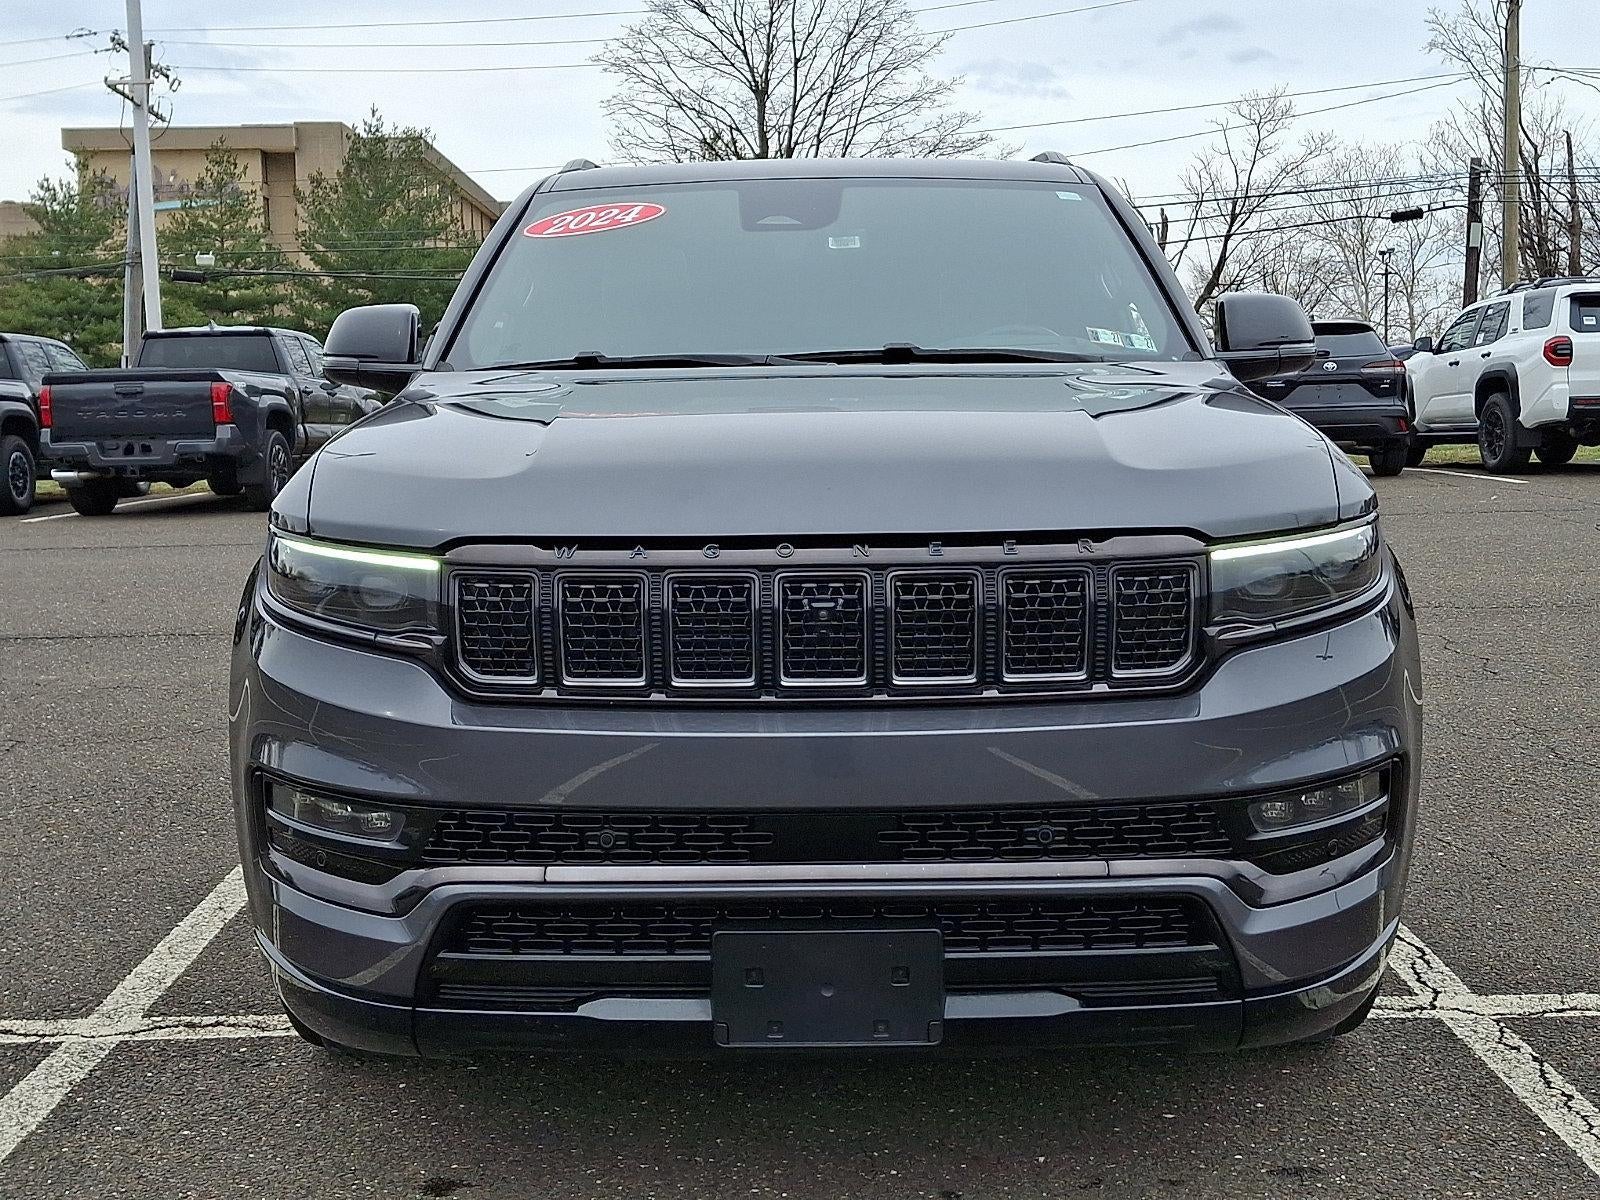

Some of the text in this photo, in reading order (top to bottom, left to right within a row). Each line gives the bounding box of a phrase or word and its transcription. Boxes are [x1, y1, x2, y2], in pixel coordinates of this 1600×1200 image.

[543, 205, 645, 235] 2024
[77, 409, 187, 419] TACOMA
[553, 538, 1095, 559] WAGONEER
